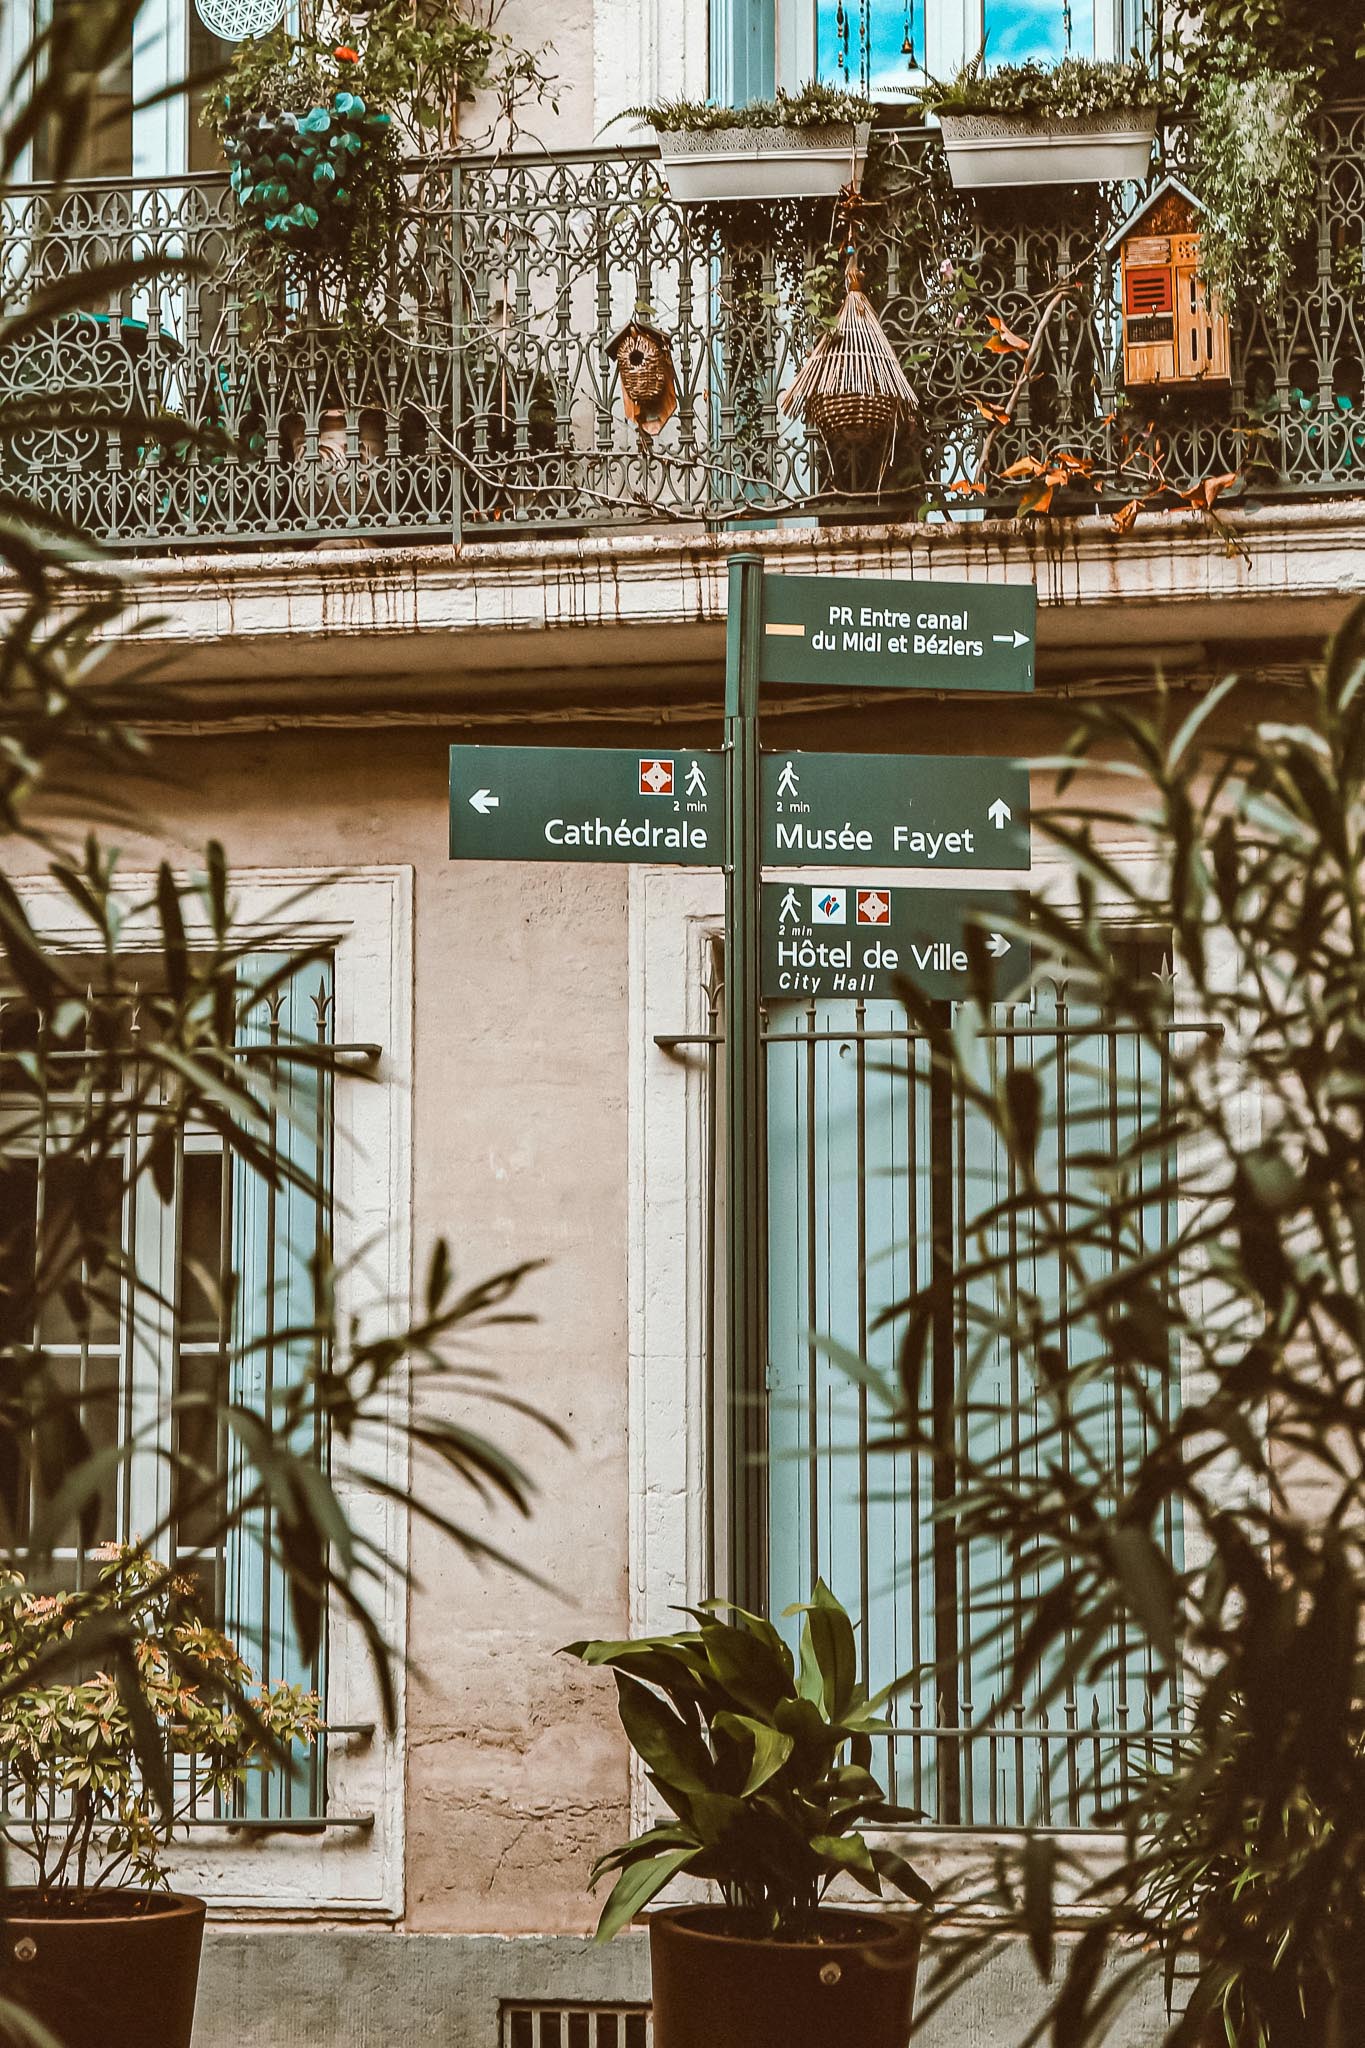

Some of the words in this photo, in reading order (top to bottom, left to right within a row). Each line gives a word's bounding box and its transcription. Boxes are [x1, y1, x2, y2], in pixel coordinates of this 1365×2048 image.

[829, 606, 854, 626] PR
[860, 607, 911, 628] Entre
[916, 611, 968, 630] canal
[811, 631, 836, 650] du
[842, 631, 882, 652] Midi
[887, 635, 908, 653] et
[913, 634, 984, 656] Béziers
[673, 800, 680, 811] 2
[686, 800, 707, 812] min
[776, 801, 783, 812] 2
[789, 801, 810, 813] min
[544, 817, 708, 848] Cathédrale
[776, 822, 873, 851] Musée
[893, 825, 975, 859] Fayet
[778, 924, 786, 936] 2
[791, 925, 813, 937] min
[778, 939, 851, 968] Hôtel
[863, 940, 899, 970] de
[910, 942, 969, 971] Ville
[779, 972, 821, 994] City
[833, 973, 875, 991] Hall
